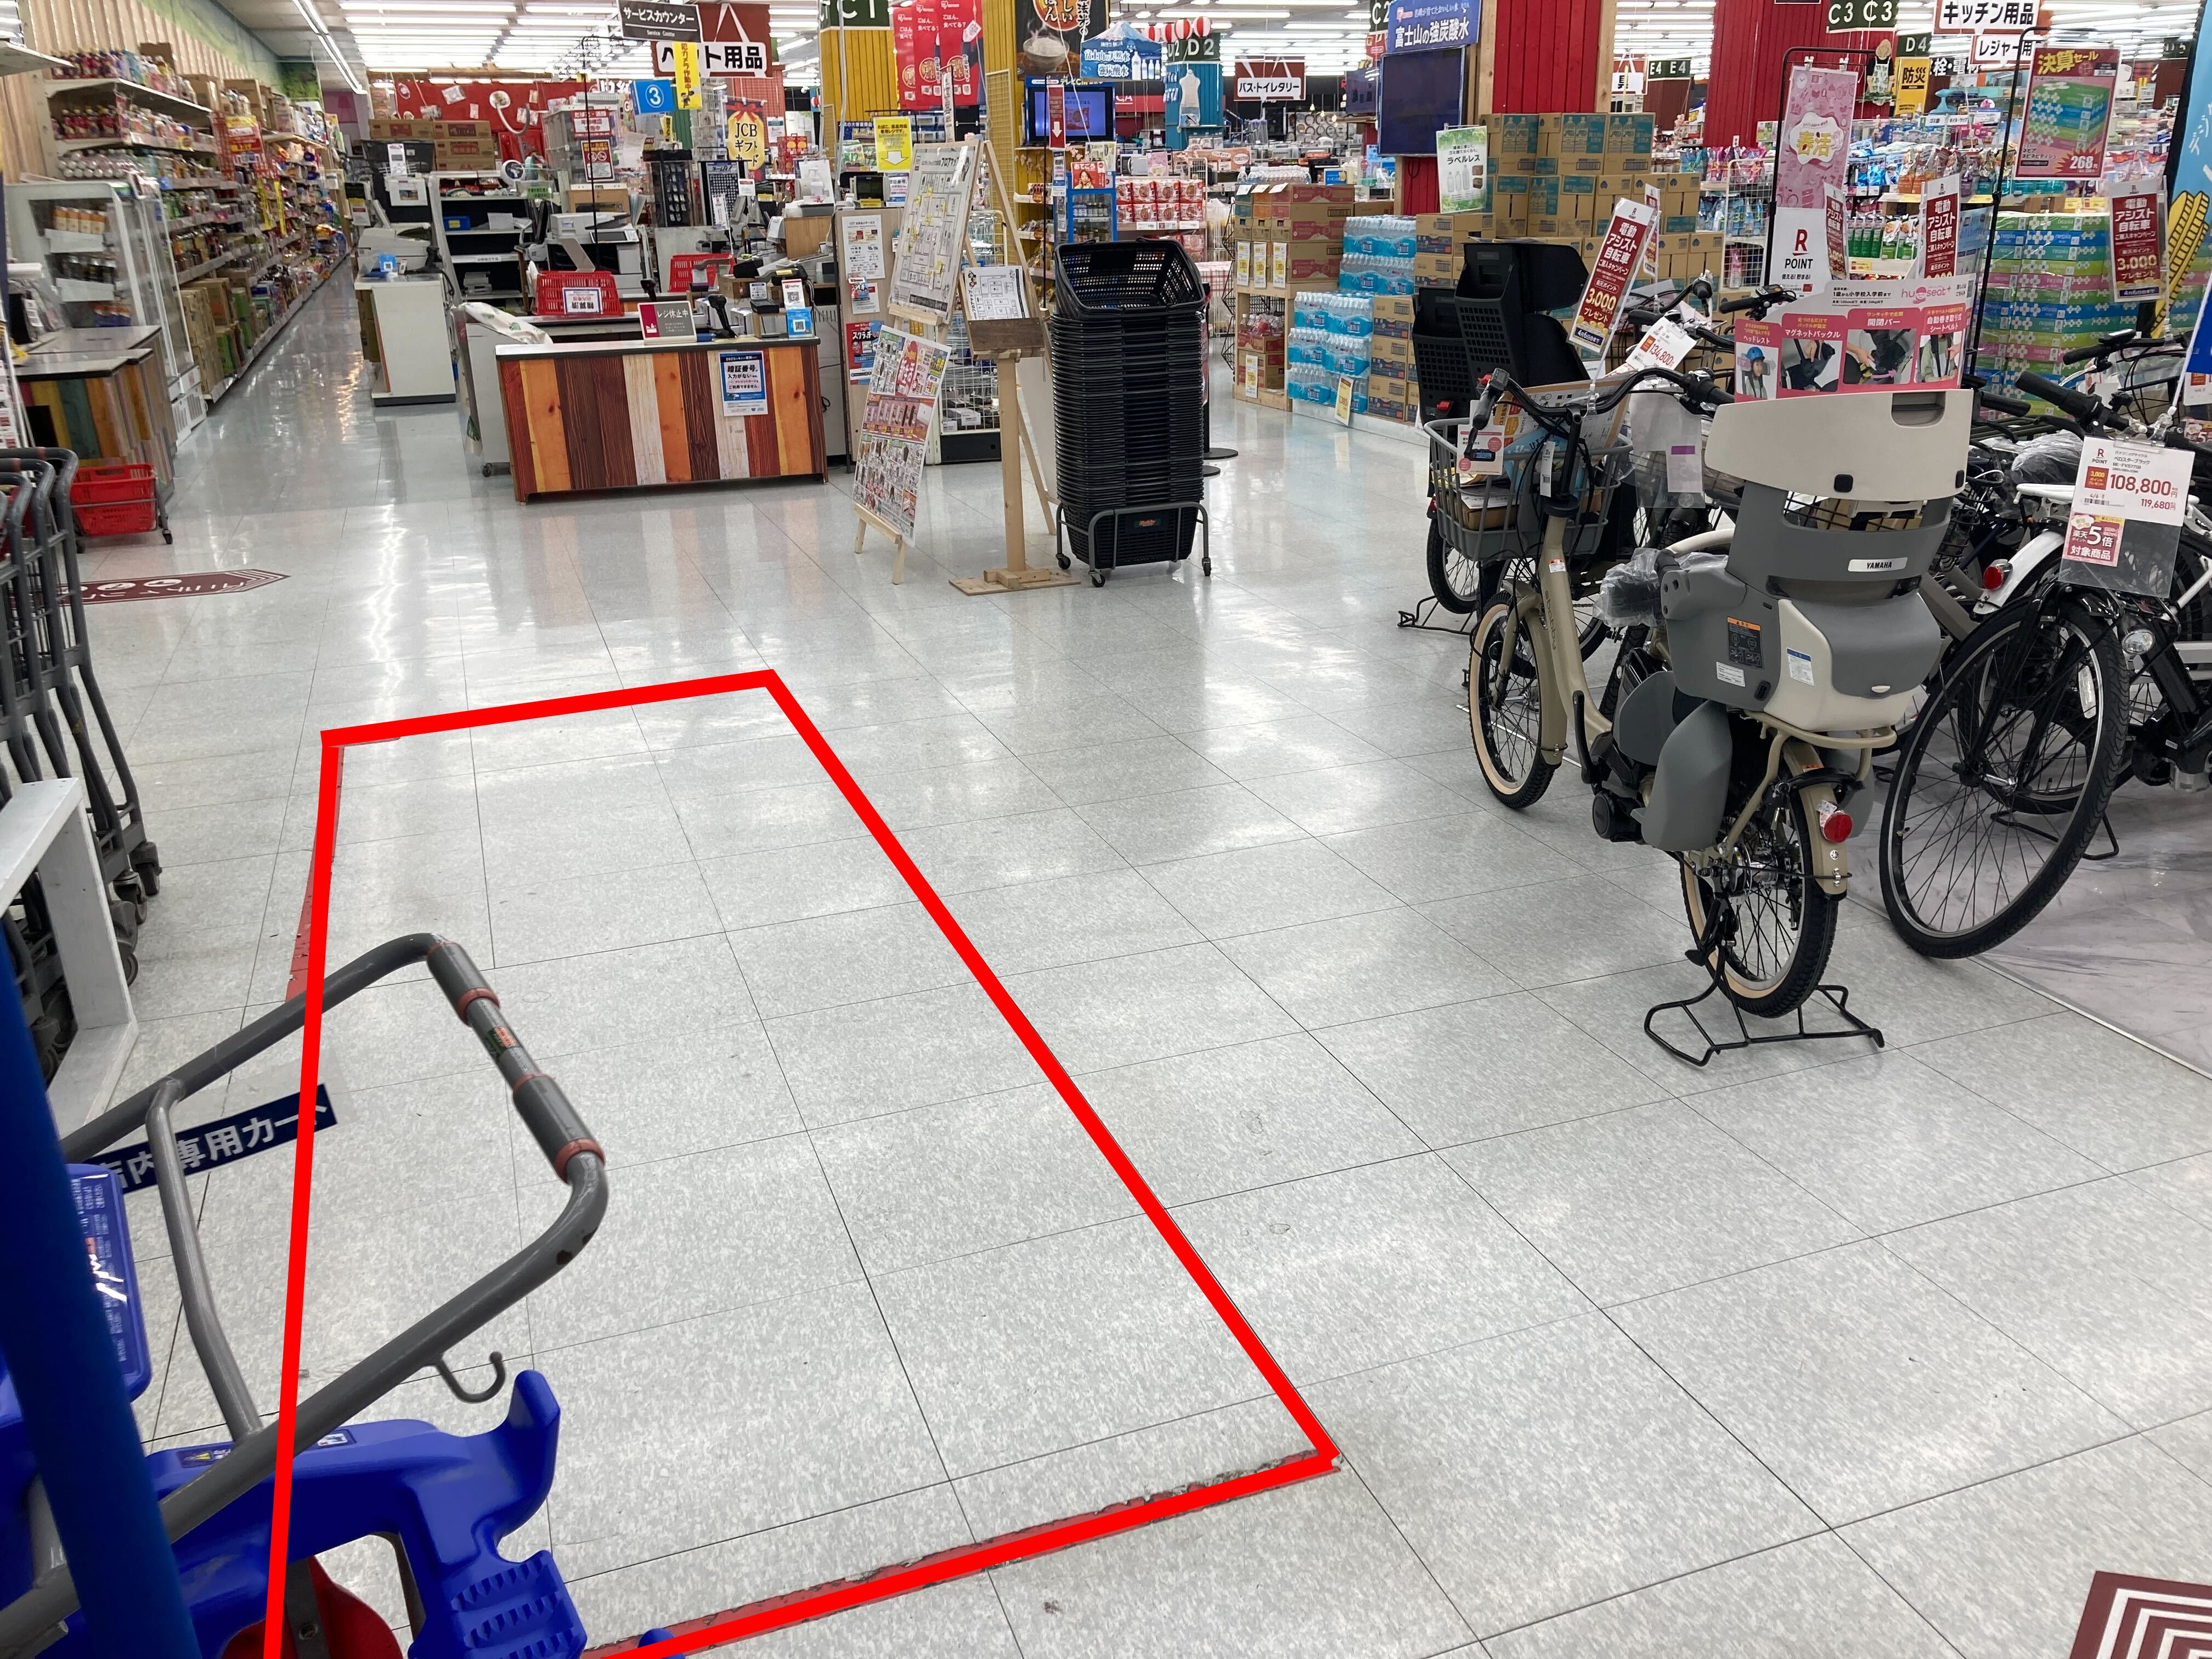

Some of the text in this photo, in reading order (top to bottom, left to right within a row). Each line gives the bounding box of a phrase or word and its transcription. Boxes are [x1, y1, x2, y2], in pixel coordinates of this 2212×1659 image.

[623, 7, 695, 25] サービスカウンター
[1829, 2, 1854, 25] C3
[1943, 2, 2034, 25] キッチン用品
[1395, 16, 1470, 48] 富士山の強炭酸水
[1906, 37, 1927, 52] D4
[1979, 40, 2042, 57] レジャー用
[1669, 60, 1686, 74] E4
[2038, 49, 2100, 76] 決算セール
[1901, 66, 1927, 84] 防災
[1238, 82, 1300, 94] バス・トイレタリー
[735, 122, 758, 138] JCB
[735, 139, 758, 153] ギフト
[1447, 154, 1480, 165] ラベルレス
[1927, 213, 1956, 230] アシスト
[2115, 208, 2155, 222] アシスト
[1618, 222, 1638, 238] 電動
[2118, 219, 2151, 233] 自転車
[1606, 233, 1638, 250] アシスト
[1795, 229, 1808, 251] R
[1929, 227, 1953, 243] 自転車
[1604, 246, 1632, 264] 自転車
[2117, 254, 2158, 271] 3,000
[1784, 258, 1814, 269] POINT
[2121, 270, 2155, 280] プレゼント
[1585, 287, 1617, 311] 3,000
[657, 308, 689, 319] レジ休止中
[1584, 307, 1609, 324] プレゼント
[1785, 329, 1841, 338] マグネットバックル
[1929, 323, 1959, 333] シートベルト
[1743, 335, 1770, 345] ヘッドレスト
[1649, 343, 1674, 366] 134,800
[2097, 448, 2104, 458] R
[2087, 526, 2102, 545] 5
[2102, 537, 2114, 548] 倍
[2070, 545, 2111, 561] 対象商品
[1866, 561, 1892, 569] YAMAHA
